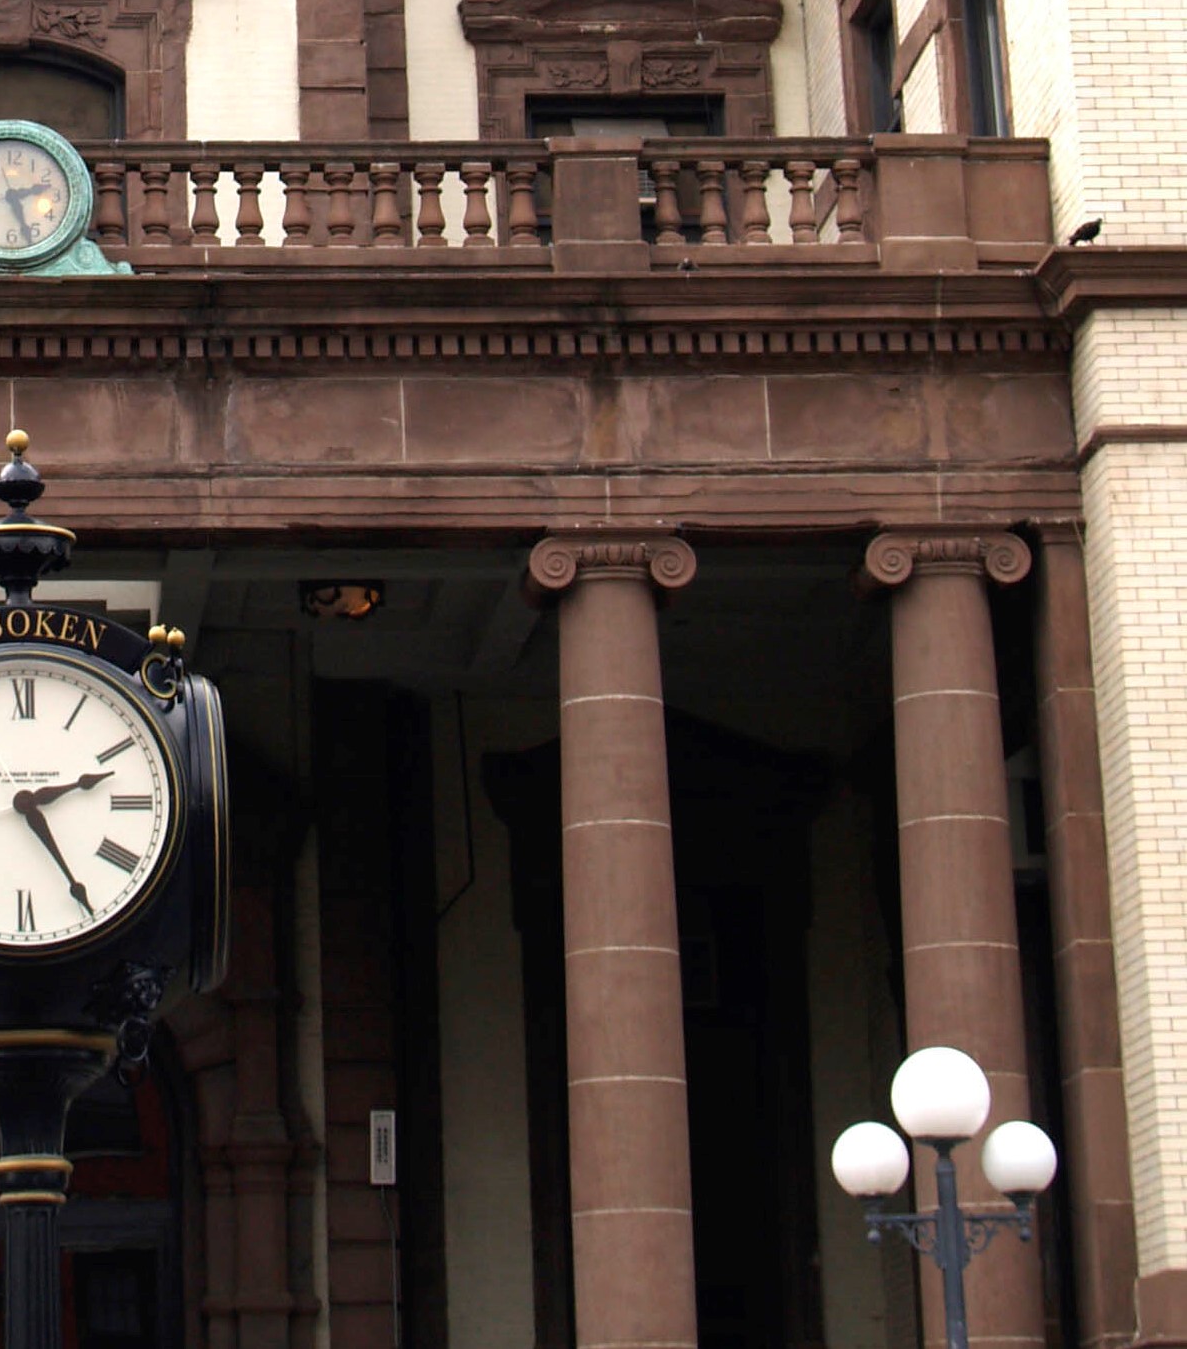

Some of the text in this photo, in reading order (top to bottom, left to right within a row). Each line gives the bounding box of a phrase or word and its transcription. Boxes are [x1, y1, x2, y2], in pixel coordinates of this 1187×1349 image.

[8, 151, 22, 165] 12
[41, 170, 51, 183] 2
[54, 190, 61, 202] 3
[44, 209, 54, 221] 4
[7, 230, 17, 243] 6
[30, 223, 40, 237] 5
[11, 678, 37, 720] XII
[64, 693, 89, 731] I
[95, 736, 136, 765] II
[110, 795, 153, 811] III
[15, 889, 37, 932] VI
